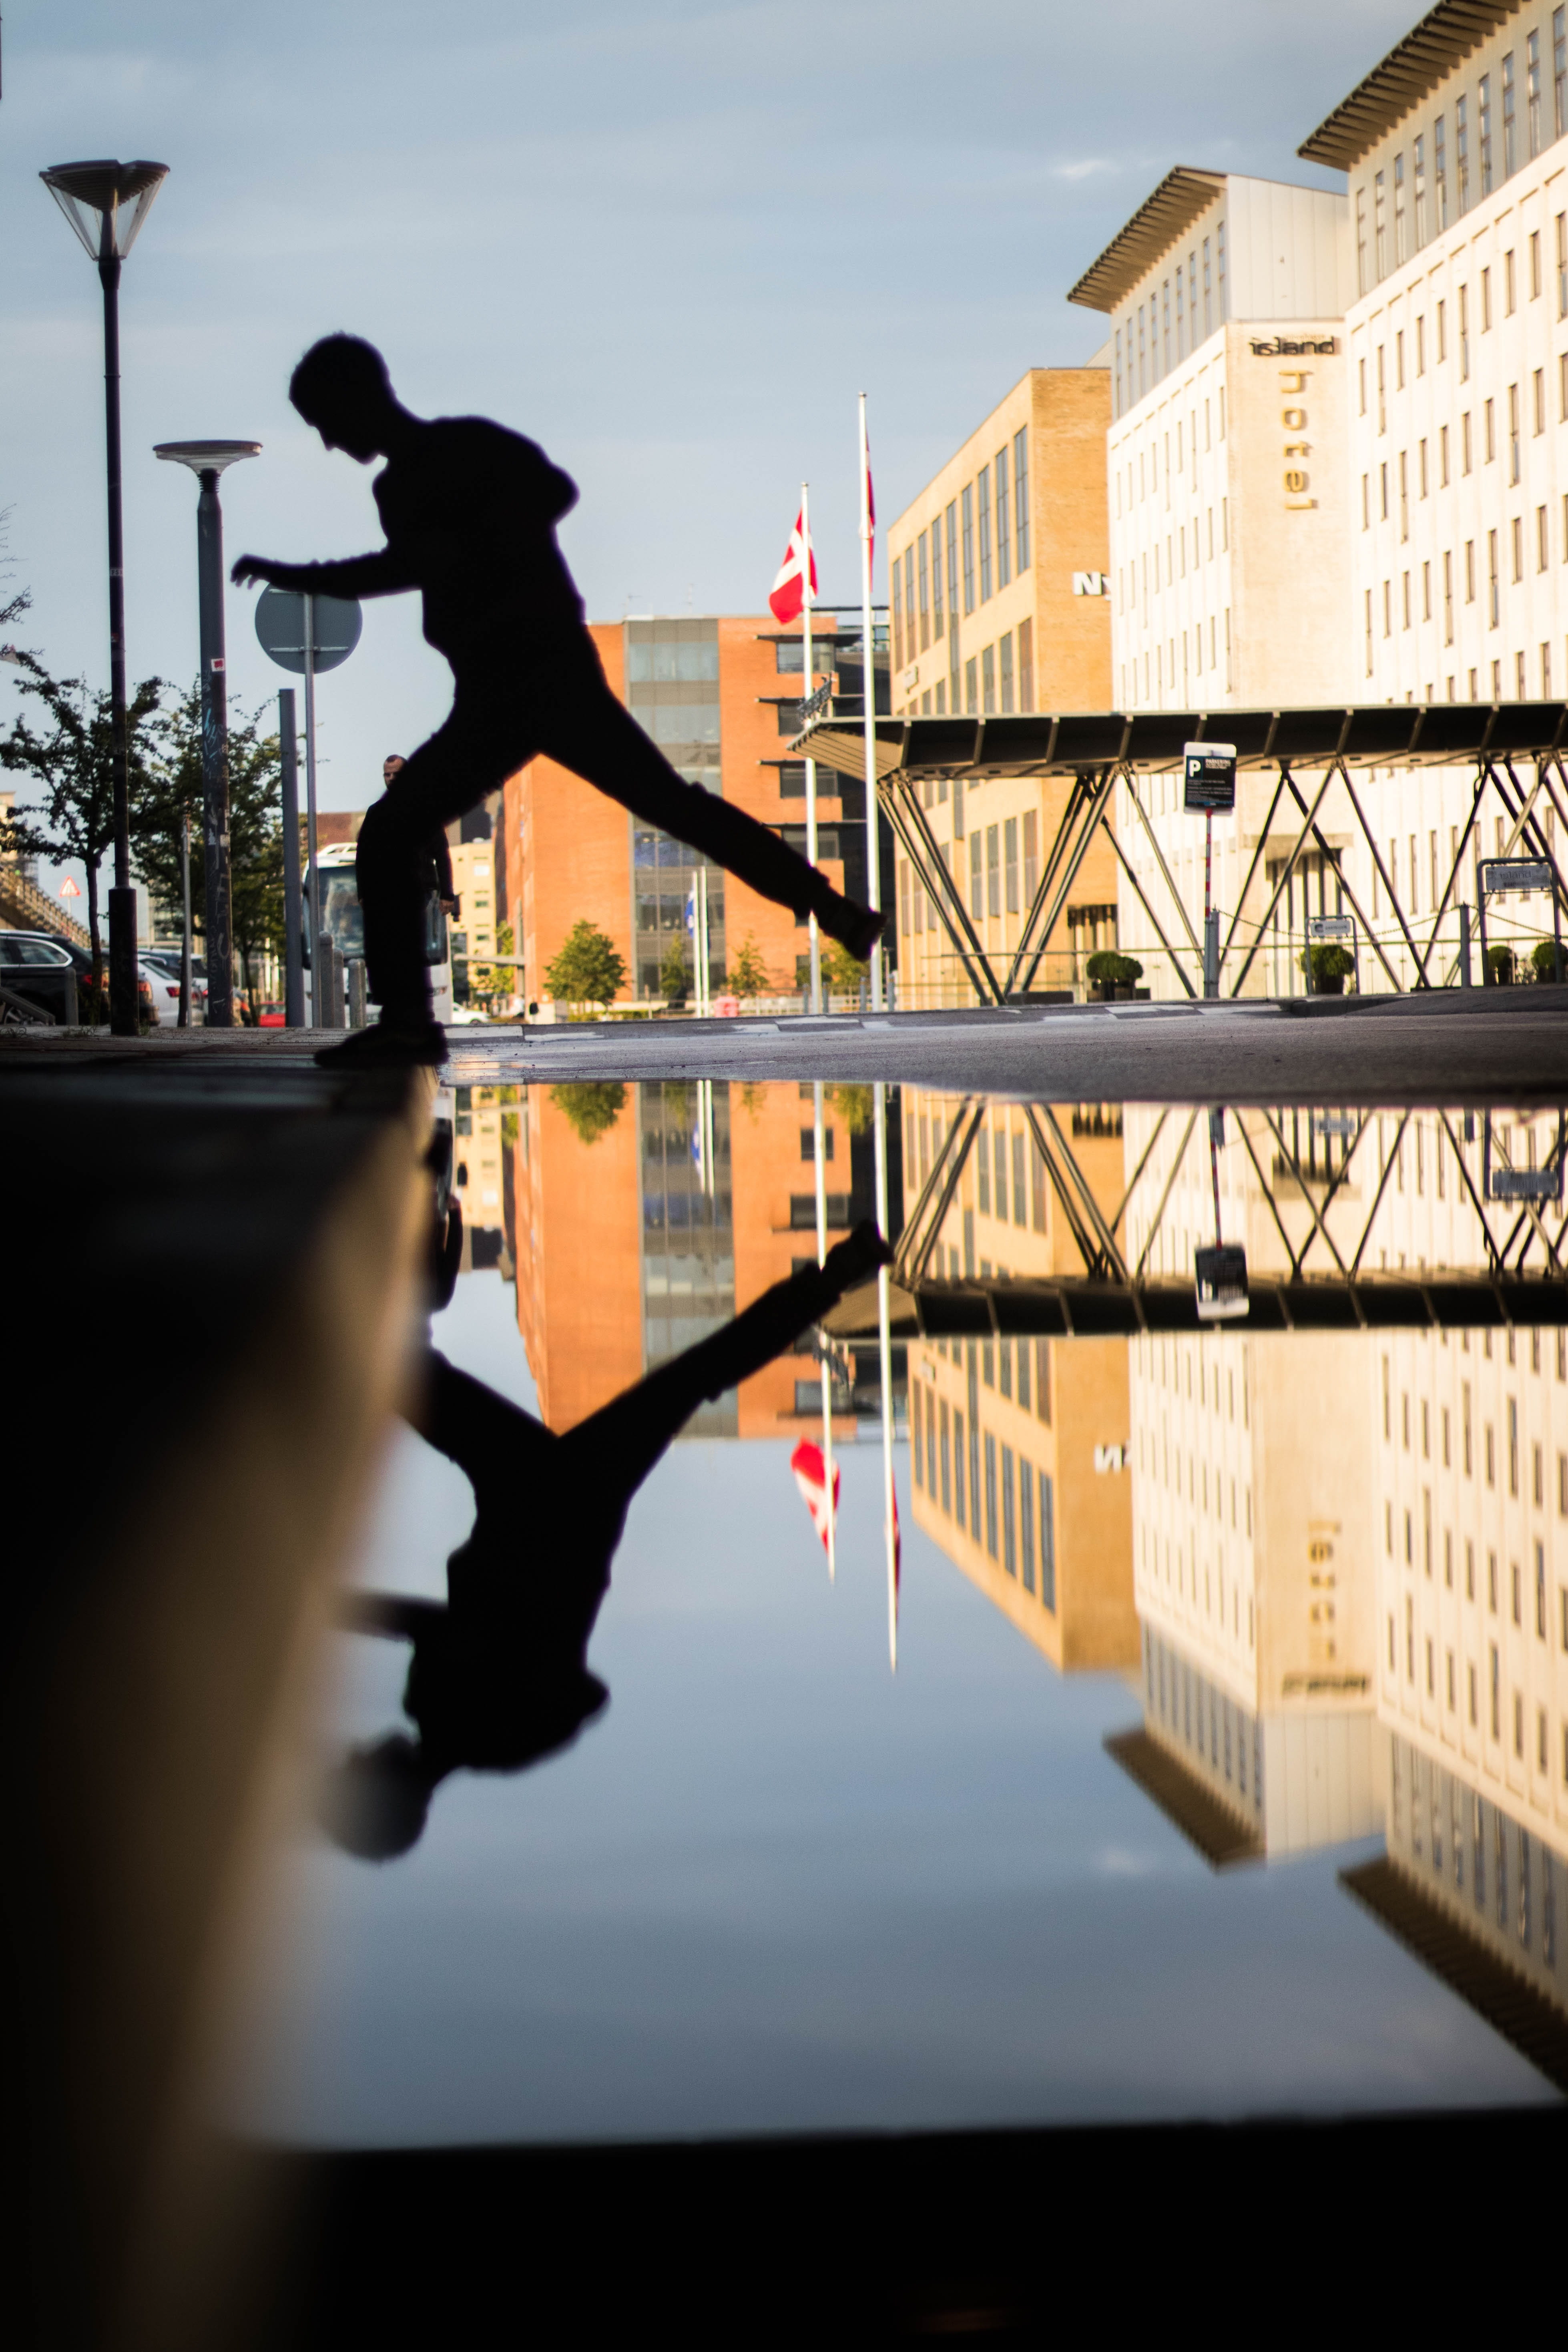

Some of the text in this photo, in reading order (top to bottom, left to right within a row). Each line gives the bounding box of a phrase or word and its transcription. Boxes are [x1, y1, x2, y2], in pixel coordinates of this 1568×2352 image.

[1249, 335, 1334, 355] island
[1279, 370, 1313, 510] hotel
[1189, 759, 1201, 777] P
